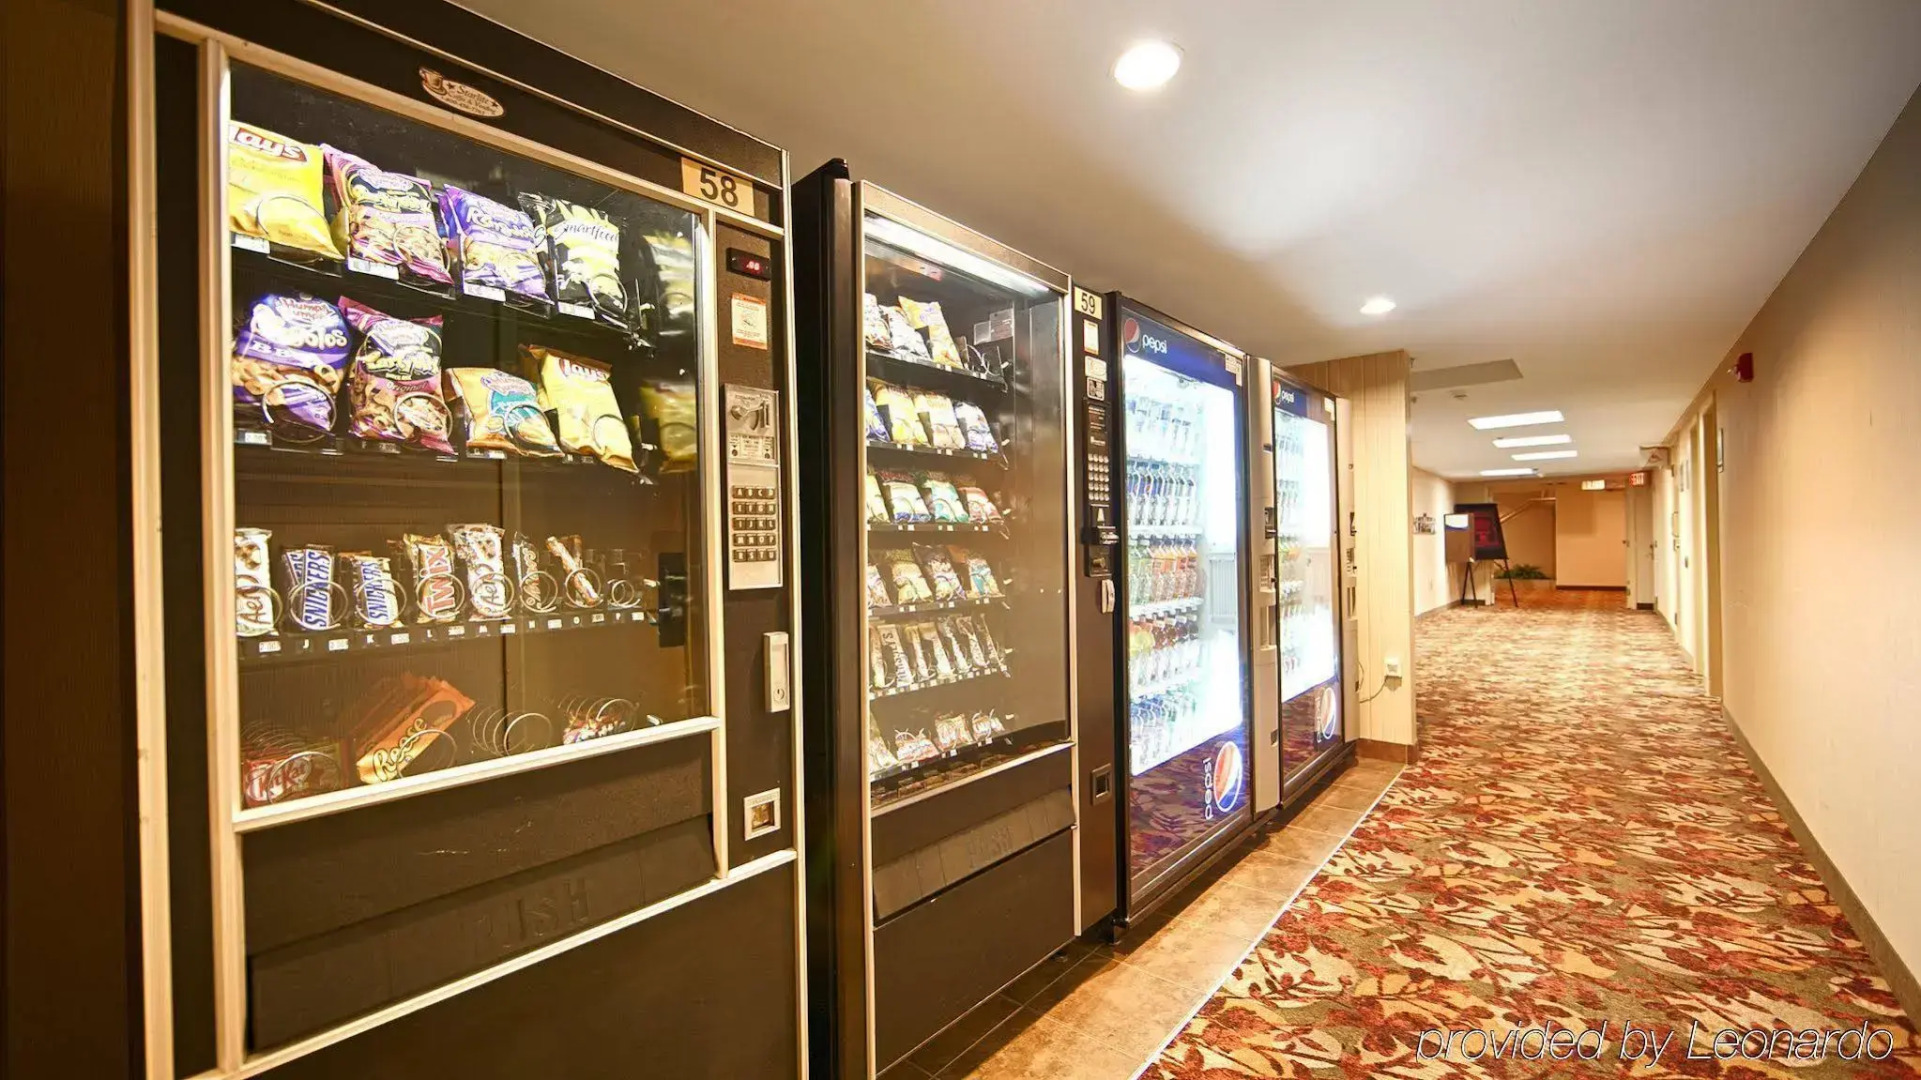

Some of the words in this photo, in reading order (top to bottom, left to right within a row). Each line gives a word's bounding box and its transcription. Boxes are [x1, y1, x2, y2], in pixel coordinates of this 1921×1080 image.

[700, 168, 739, 207] 58
[1081, 292, 1096, 314] 59
[1142, 334, 1168, 354] pepsi
[304, 551, 330, 627] SNICKERS
[361, 561, 389, 620] SNICKERS
[1203, 757, 1213, 820] pepsi
